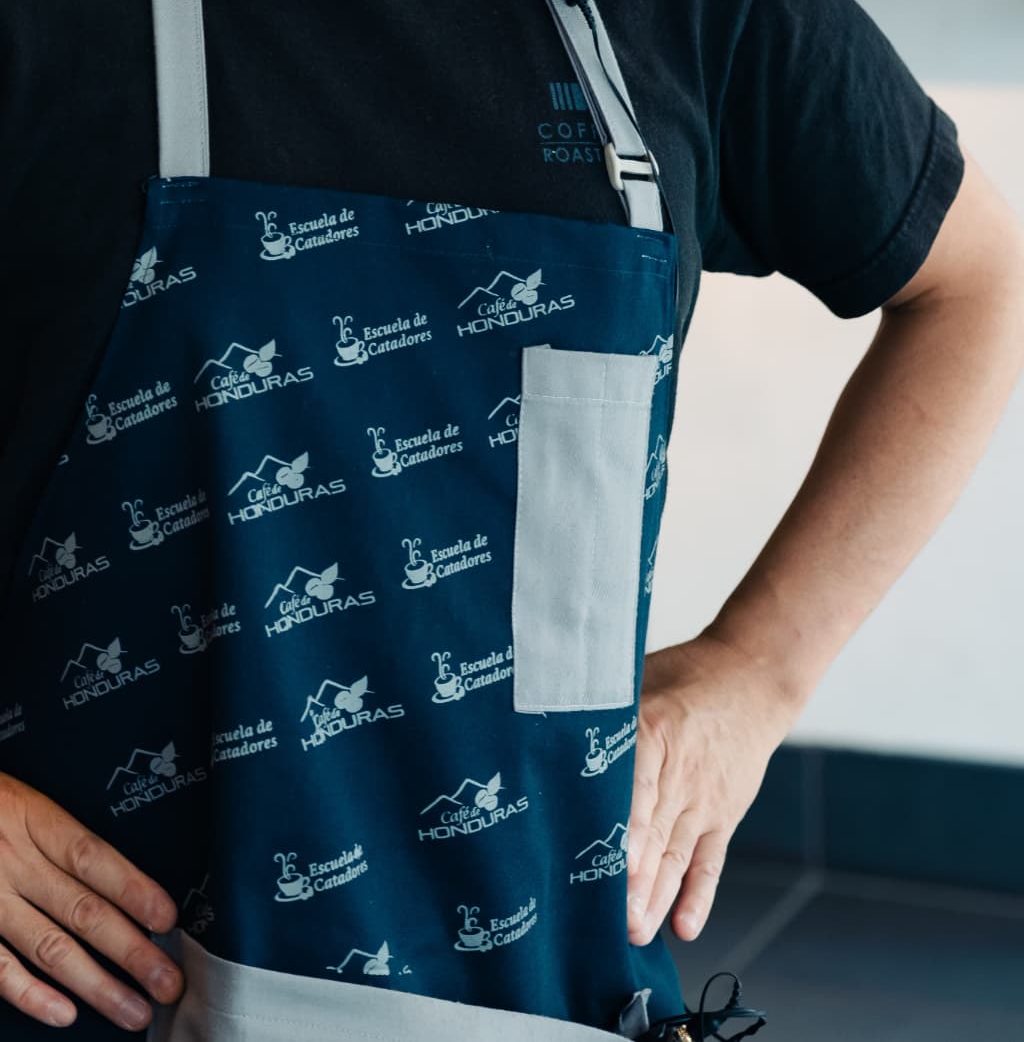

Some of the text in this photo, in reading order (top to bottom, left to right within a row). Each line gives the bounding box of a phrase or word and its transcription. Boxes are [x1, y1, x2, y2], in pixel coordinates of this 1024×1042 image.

[543, 148, 601, 163] ROAST
[288, 208, 355, 235] Escuela de
[294, 226, 360, 251] Catadores
[120, 266, 197, 309] DURAS
[363, 313, 428, 341] Escuela de
[457, 294, 576, 337] HONDURAS
[368, 329, 433, 356] Catadores
[108, 380, 171, 416] Escuela de
[194, 366, 314, 413] HONDURAS
[115, 395, 178, 431] Catadores
[394, 423, 460, 452] Escuela de
[400, 440, 463, 468] Catadores
[228, 479, 346, 525] HONDURAS
[431, 534, 488, 563] Escuela de
[33, 555, 110, 602] HONDURAS
[436, 550, 492, 579] Catadores
[264, 591, 376, 638] HONDURAS
[460, 645, 513, 676] Escuela d
[62, 659, 161, 710] HONDURAS
[464, 667, 513, 691] Catador
[256, 718, 273, 734] de
[110, 767, 207, 817] HONDURAS
[418, 796, 529, 841] HONDURAS
[309, 851, 354, 877] Escuela
[314, 860, 368, 892] Catadores
